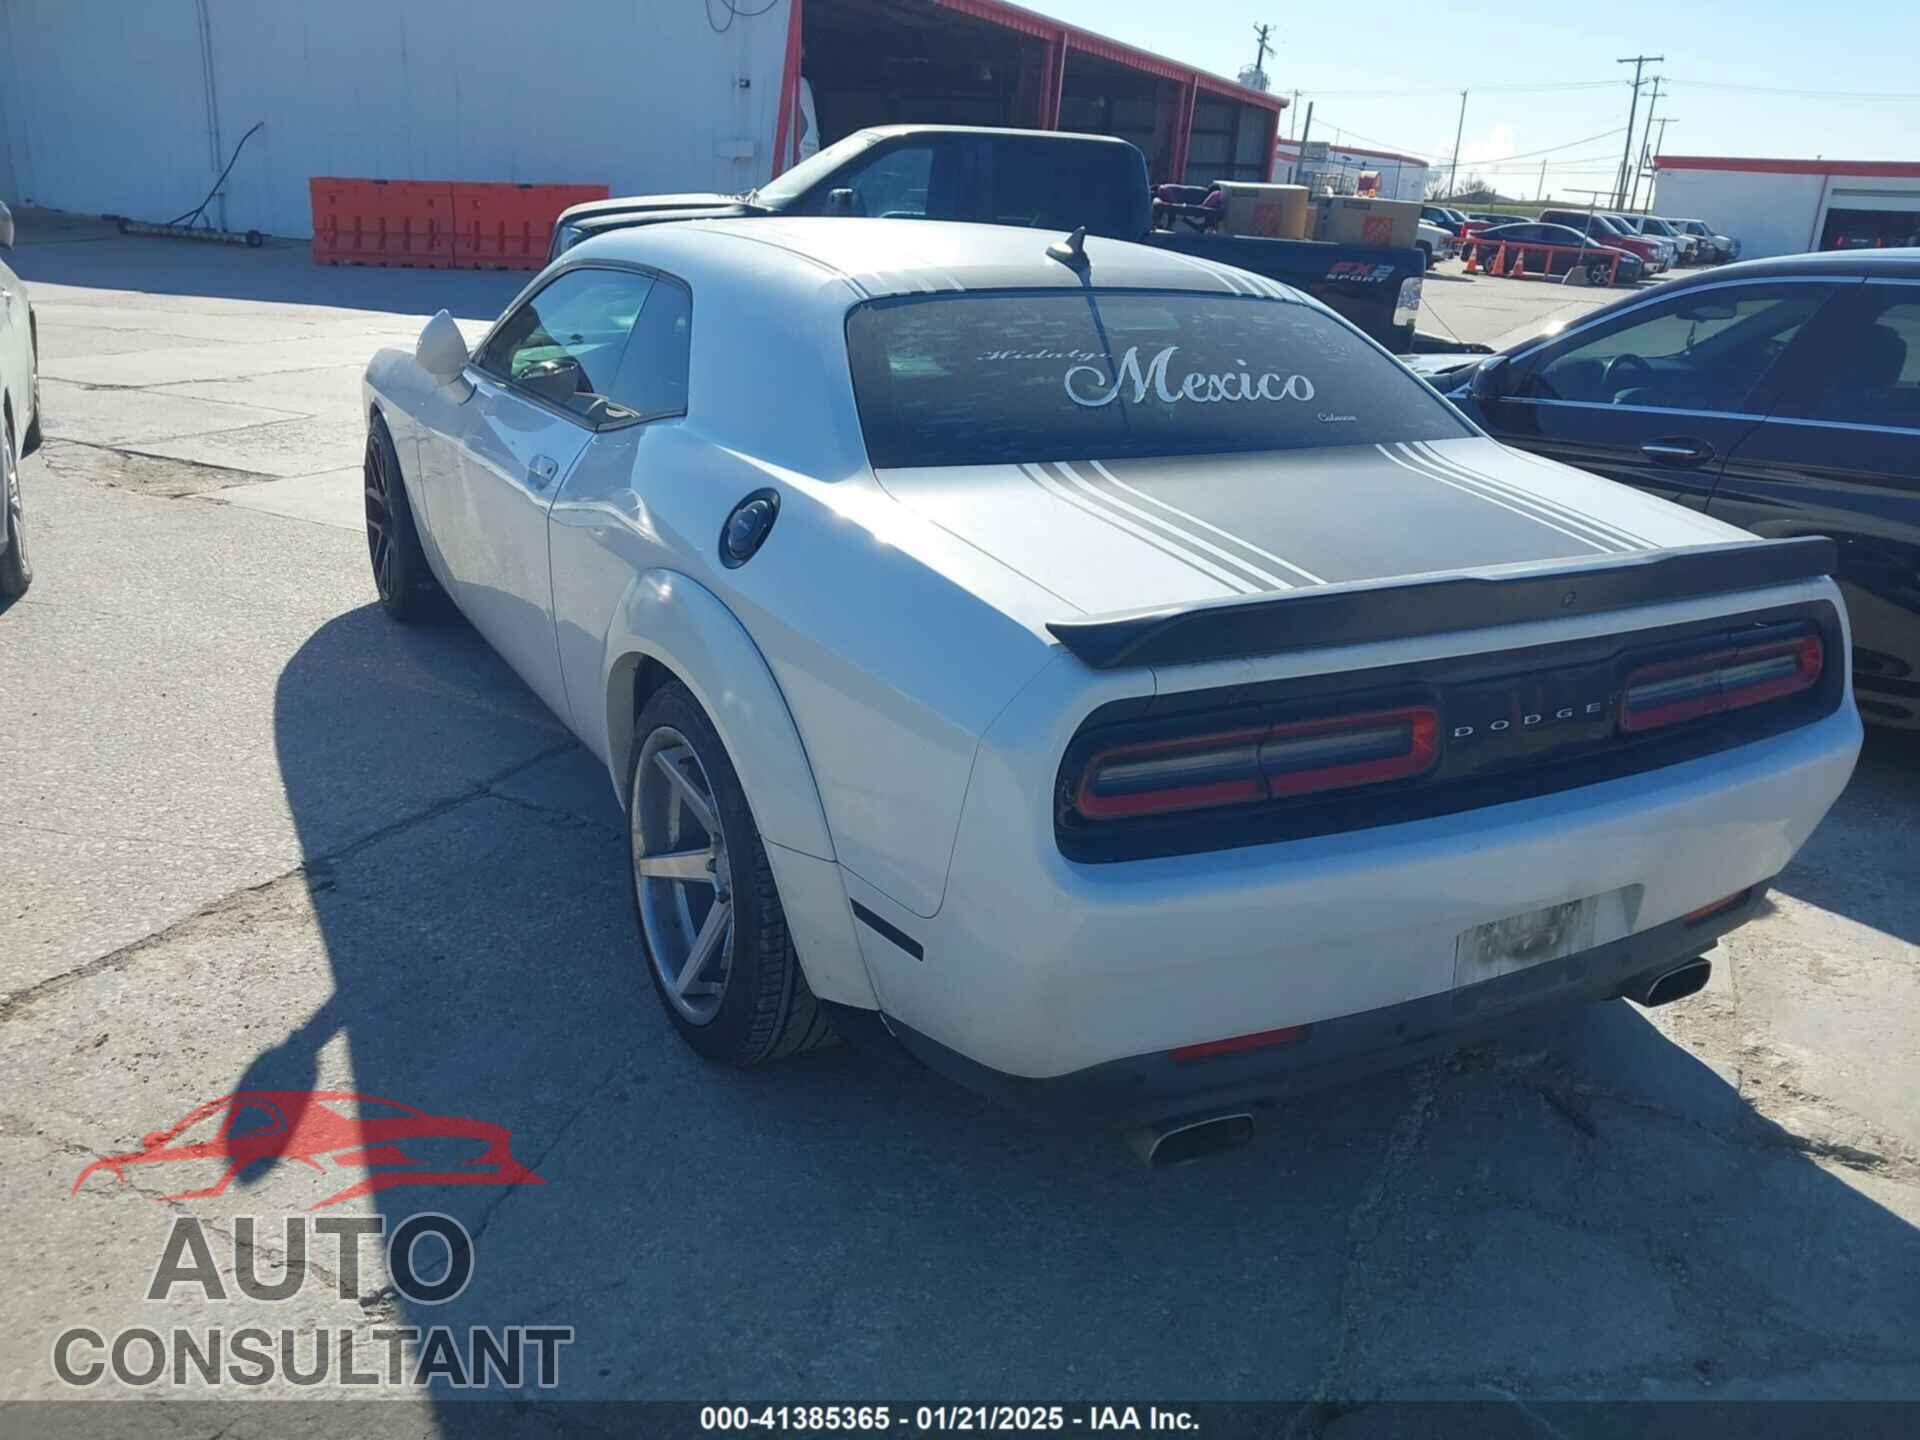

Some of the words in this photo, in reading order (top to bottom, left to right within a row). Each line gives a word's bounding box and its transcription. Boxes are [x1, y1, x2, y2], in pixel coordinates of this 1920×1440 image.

[1325, 273, 1385, 282] SPORT
[1064, 345, 1315, 406] Mexico
[1454, 702, 1602, 737] DODGE
